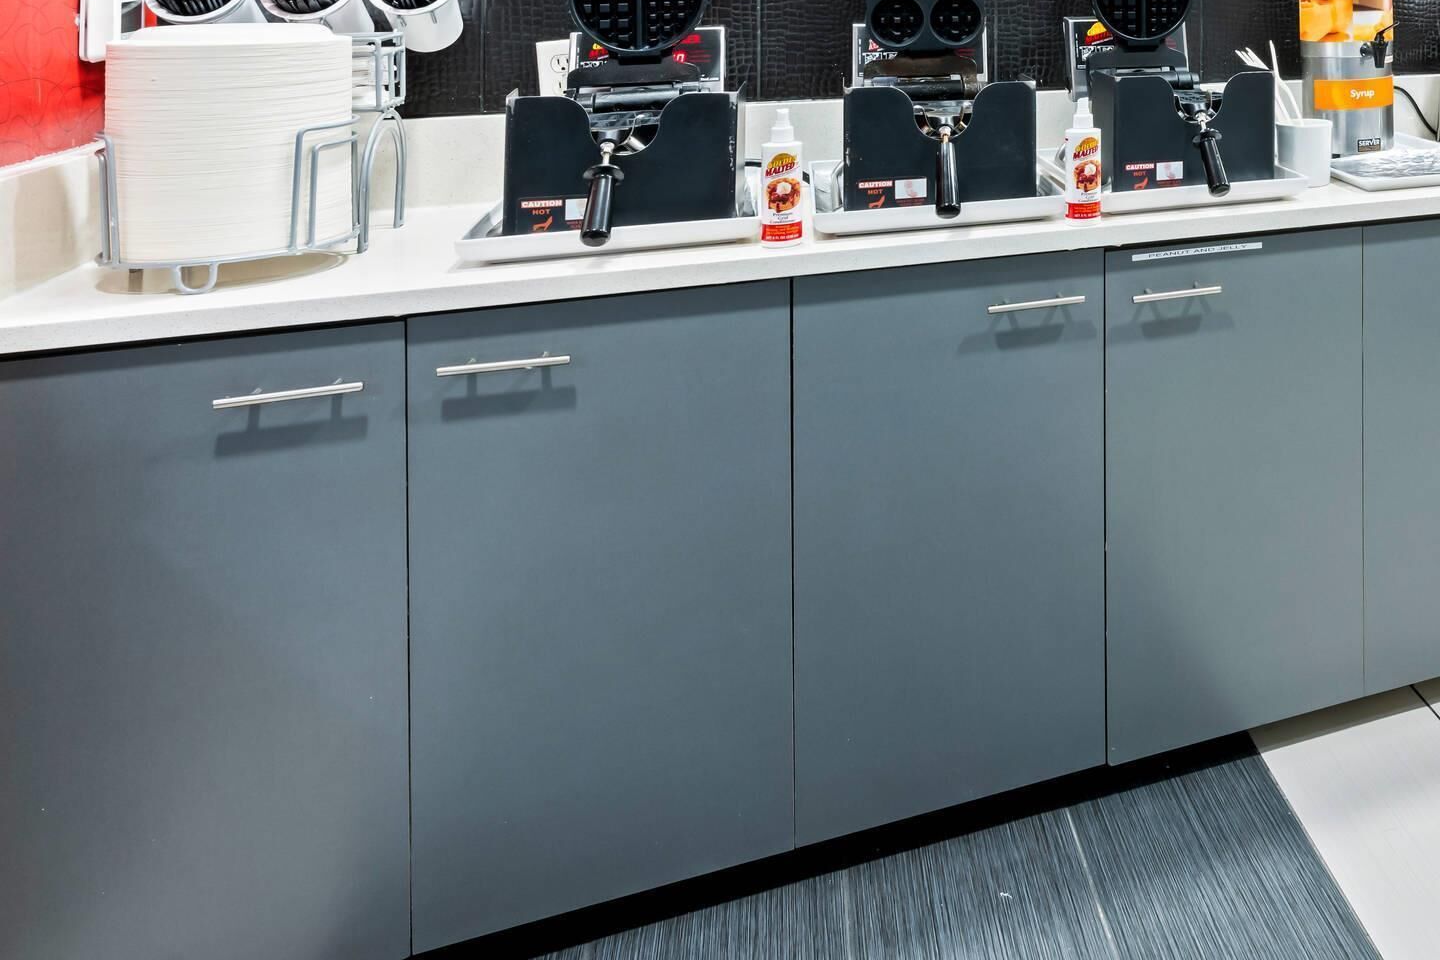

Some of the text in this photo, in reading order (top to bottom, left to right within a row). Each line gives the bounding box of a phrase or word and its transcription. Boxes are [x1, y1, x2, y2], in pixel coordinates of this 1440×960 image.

[1350, 89, 1375, 99] Syrup
[1358, 138, 1380, 146] SERVER
[765, 162, 796, 177] MALTED
[858, 180, 893, 189] CAUTION
[521, 199, 563, 208] CAUTION
[1148, 250, 1190, 259] PEANUT
